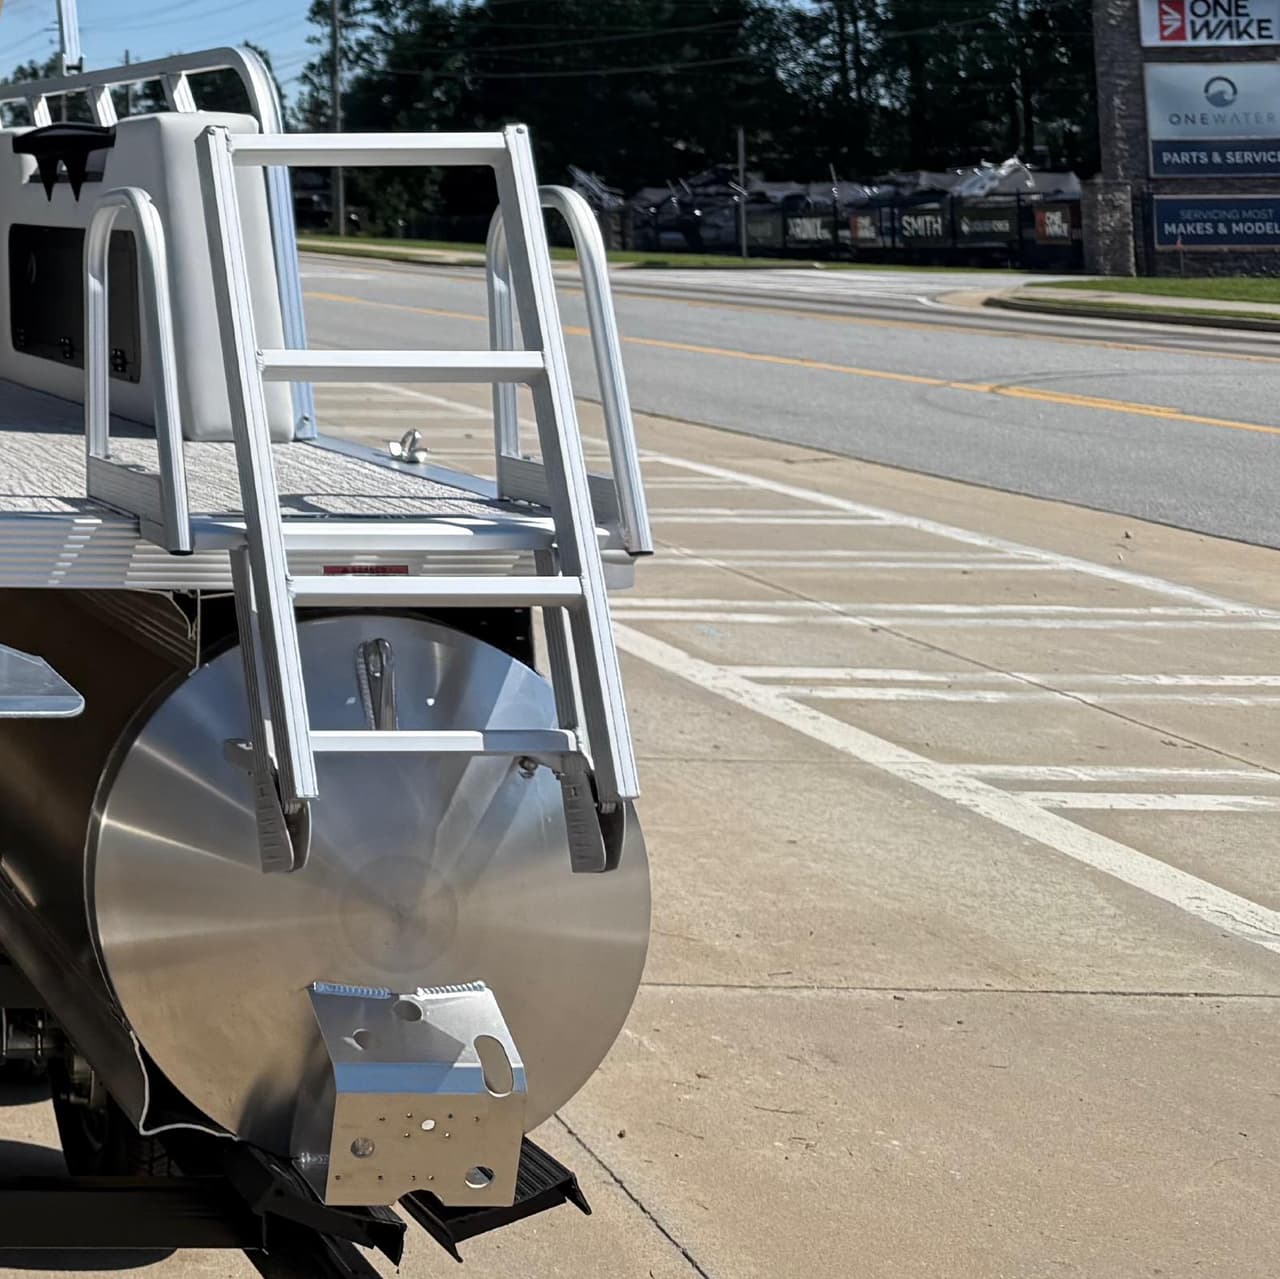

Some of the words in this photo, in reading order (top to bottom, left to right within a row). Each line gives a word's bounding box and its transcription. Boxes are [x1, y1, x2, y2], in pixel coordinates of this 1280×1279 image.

[1190, 18, 1274, 40] WAKE
[1162, 151, 1208, 164] PARTS
[1211, 151, 1222, 164] &
[1225, 151, 1280, 164] SERVIC
[902, 214, 943, 238] SMITH
[1163, 222, 1214, 235] MAKES
[1217, 222, 1228, 235] &
